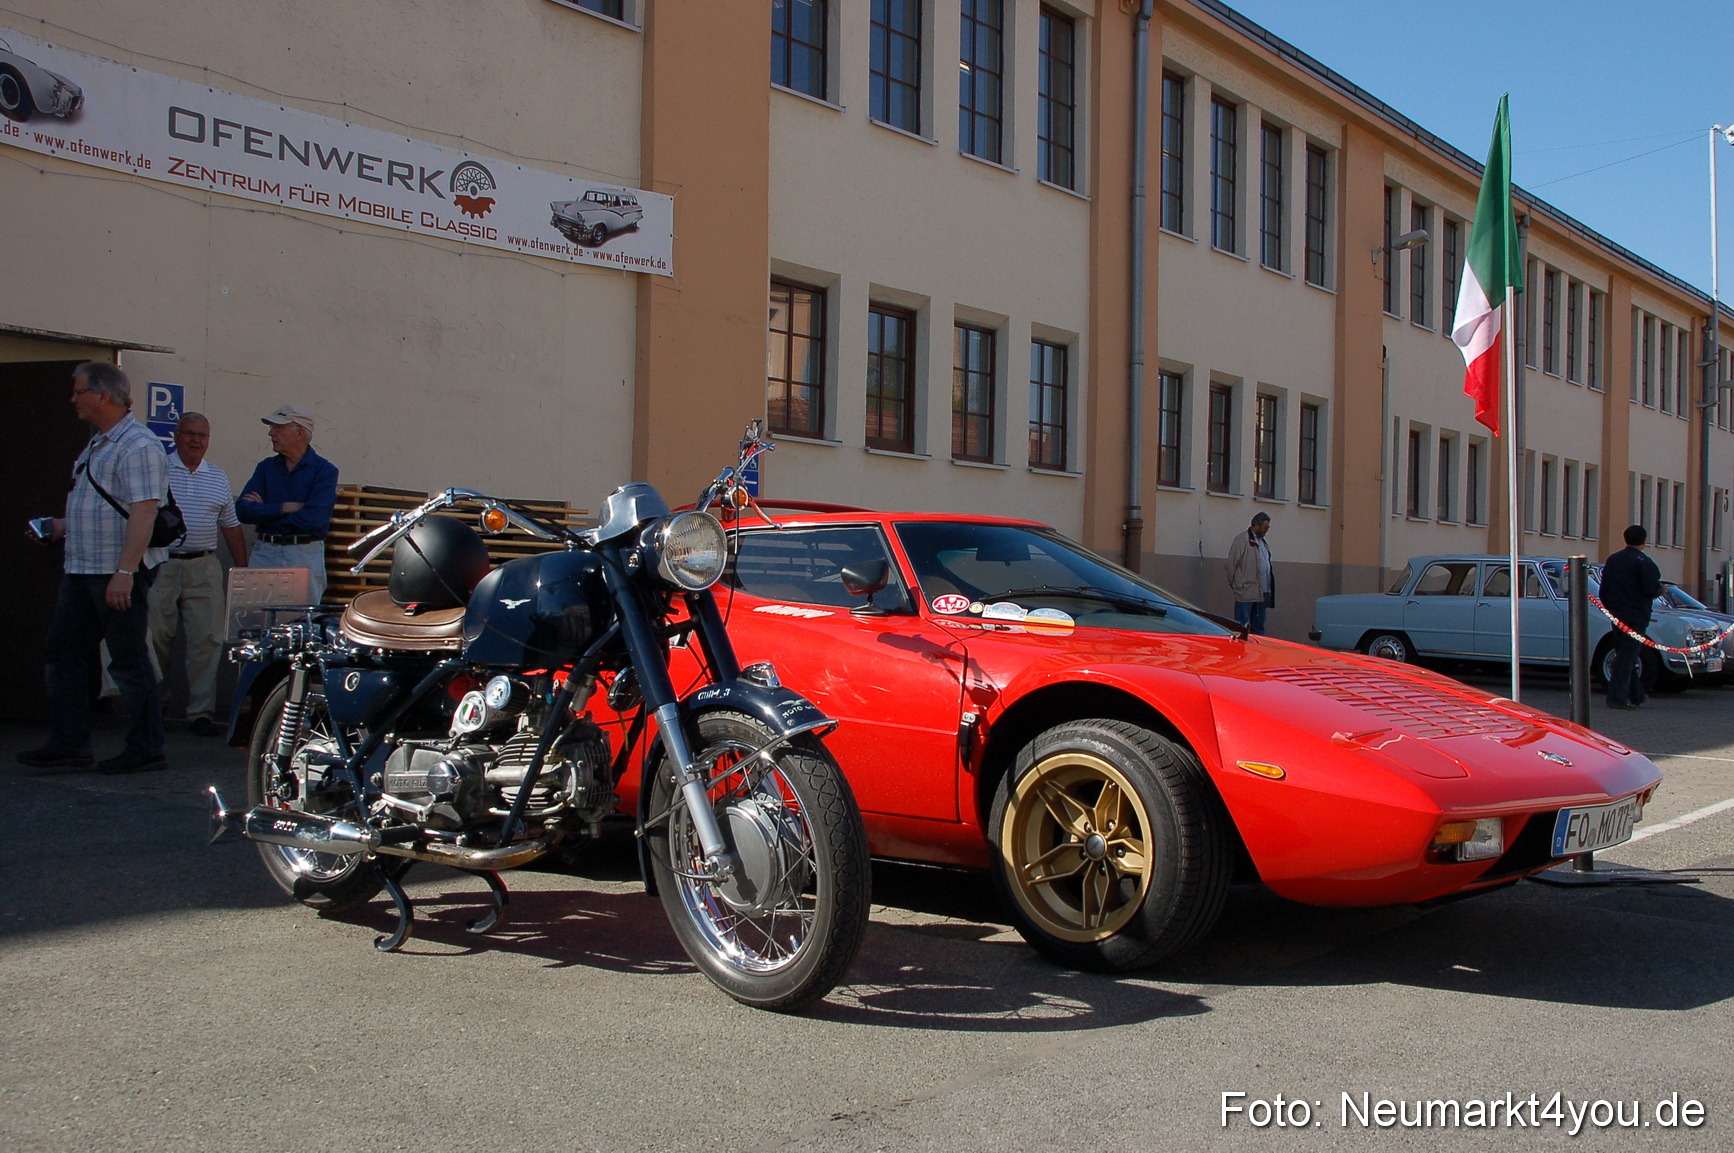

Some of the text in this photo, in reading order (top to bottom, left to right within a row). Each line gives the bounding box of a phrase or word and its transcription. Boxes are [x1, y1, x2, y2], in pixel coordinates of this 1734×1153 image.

[33, 131, 152, 170] www.ofenwerk.de
[168, 105, 447, 200] OFENWERK
[167, 156, 498, 242] ZENTRUM FÜR MOBILE CLASSIC
[507, 234, 667, 270] www.ofenwerk.de www.ofenwerk.de
[150, 386, 172, 417] P
[1565, 812, 1589, 848] FO
